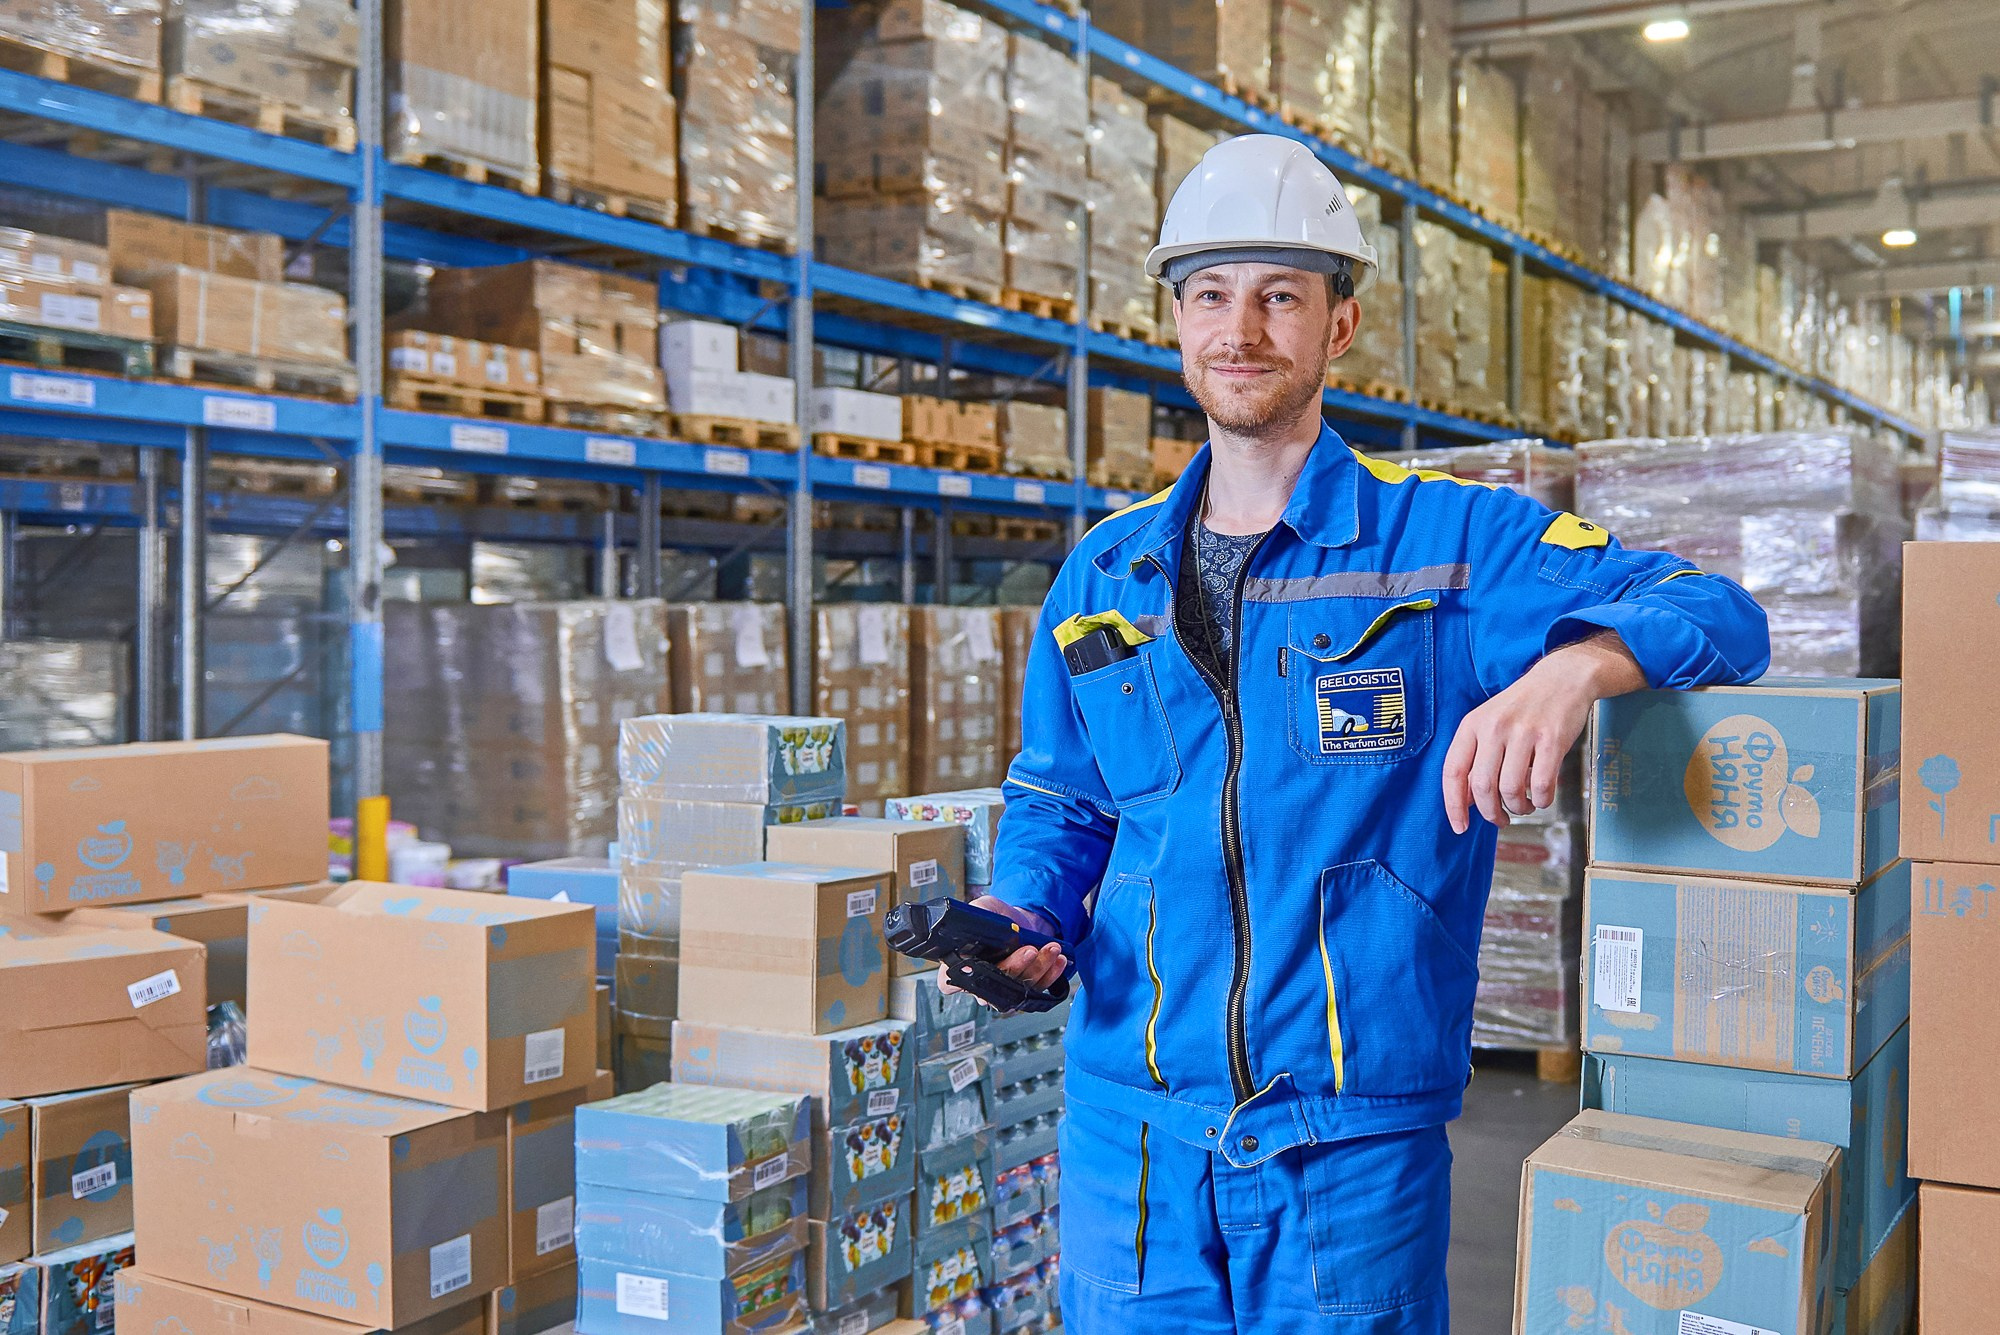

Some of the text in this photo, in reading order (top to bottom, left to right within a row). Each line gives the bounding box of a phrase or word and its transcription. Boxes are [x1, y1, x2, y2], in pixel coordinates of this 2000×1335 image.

[1320, 673, 1399, 688] BEELOGISTIC
[1324, 736, 1403, 750] The Parfum Group
[1601, 738, 1621, 812] ПЕЧЕНЬЕ
[1709, 736, 1742, 829] НЯНЯ
[1743, 732, 1776, 828] Фруто
[69, 880, 141, 900] ПАЛОЧКИ
[1811, 1016, 1825, 1069] ПЕЧЕНЬЕ
[1618, 1228, 1704, 1264] Фруто
[1622, 1255, 1704, 1292] НЯНЯ
[295, 1279, 357, 1311] ПАЛОЧКИ
